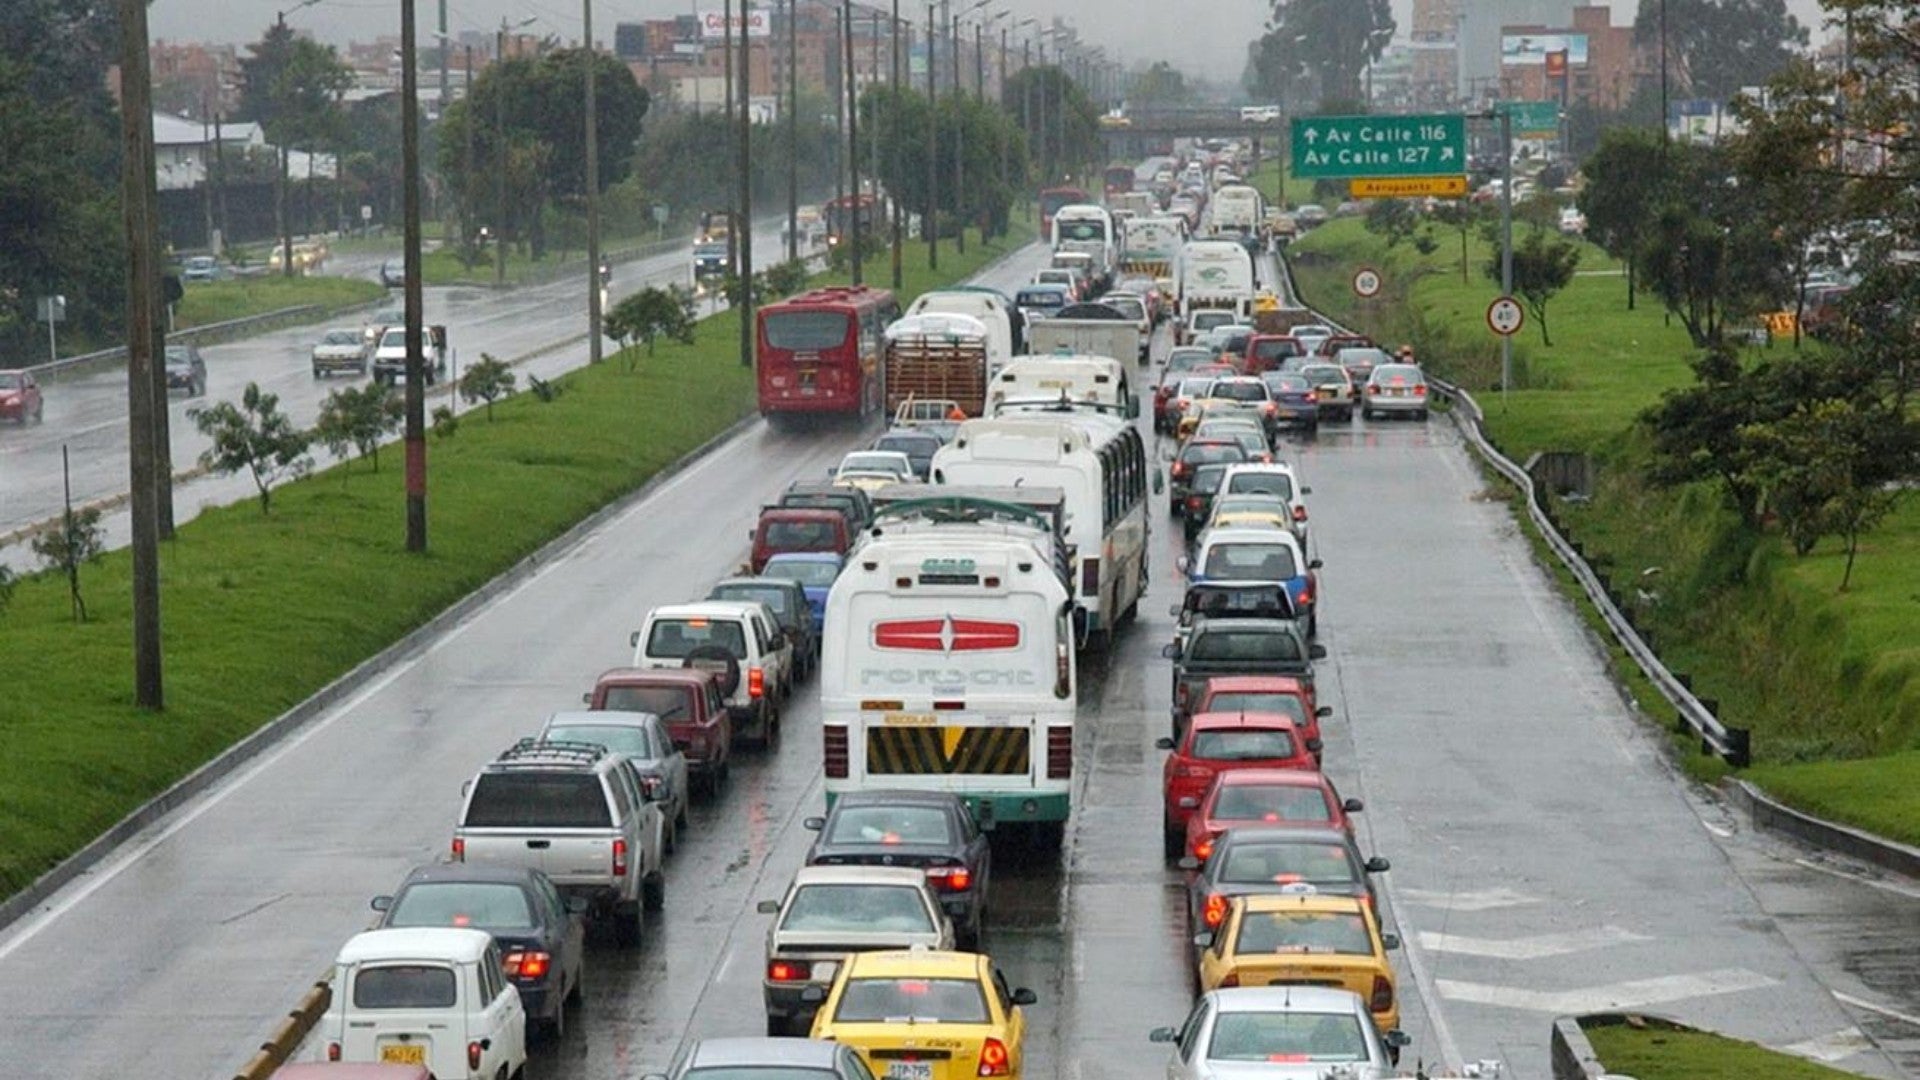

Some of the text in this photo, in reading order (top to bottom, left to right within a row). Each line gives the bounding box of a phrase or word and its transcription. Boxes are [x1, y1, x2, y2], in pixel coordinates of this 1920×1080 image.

[1326, 124, 1446, 143] Av Calle 116
[1304, 146, 1430, 165] Av Calle 127
[1365, 182, 1433, 192] Aeropuerto
